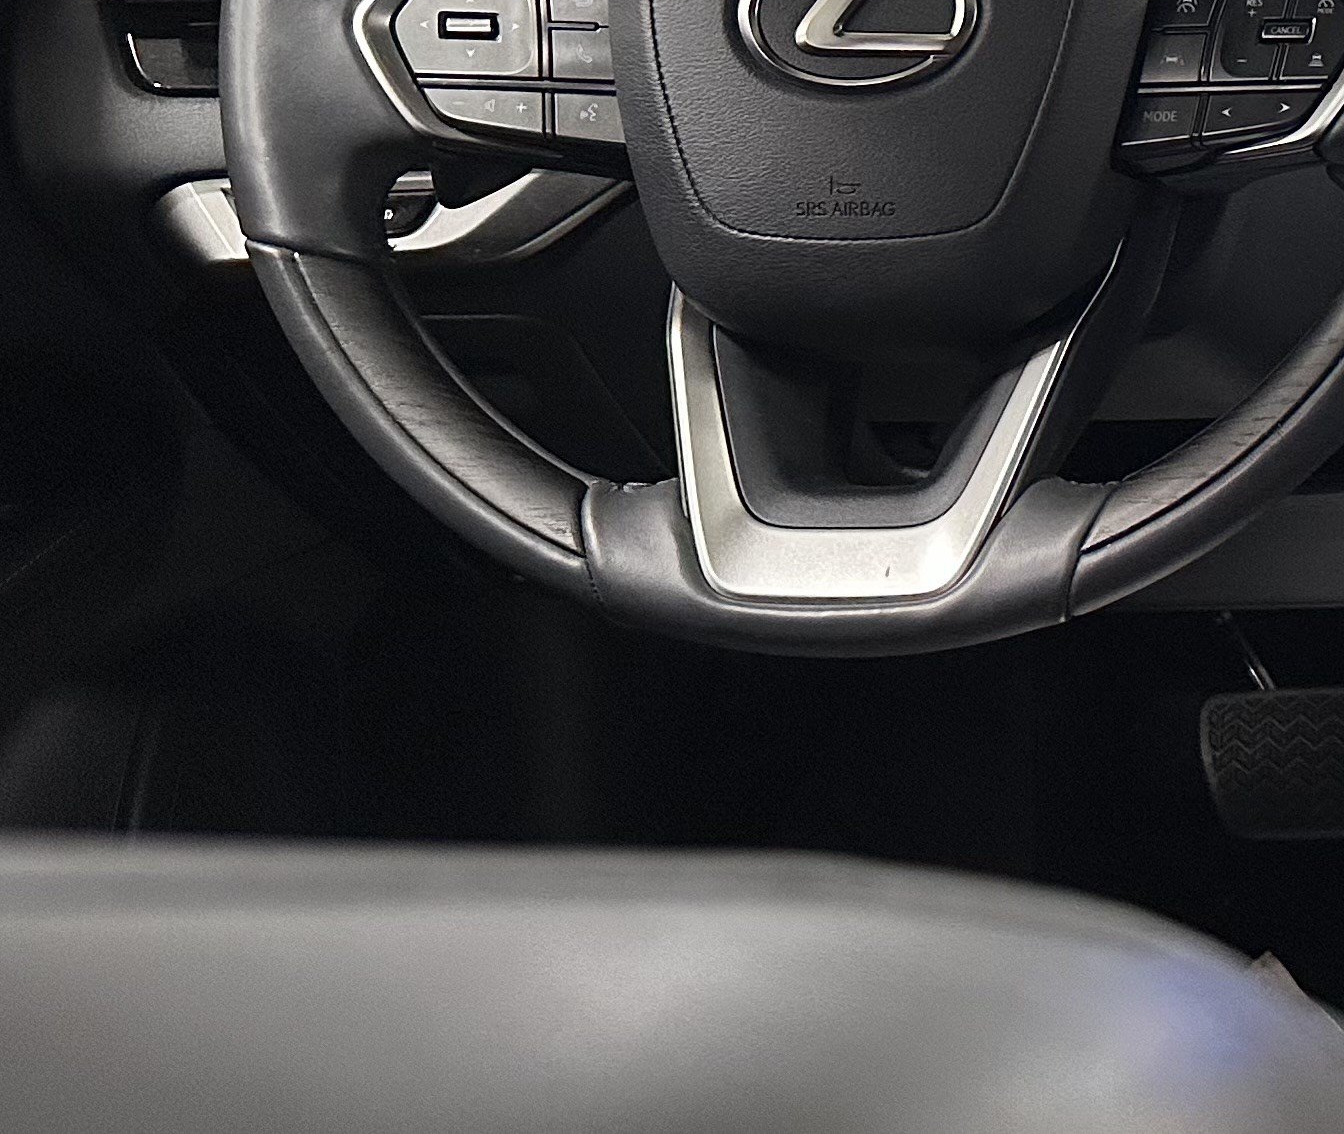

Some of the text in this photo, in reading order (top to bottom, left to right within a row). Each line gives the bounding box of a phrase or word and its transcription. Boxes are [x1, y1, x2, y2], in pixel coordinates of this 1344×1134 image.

[1270, 23, 1302, 35] CANCEL
[1143, 111, 1178, 122] MODE
[796, 201, 896, 218] SRS AIRBAG
